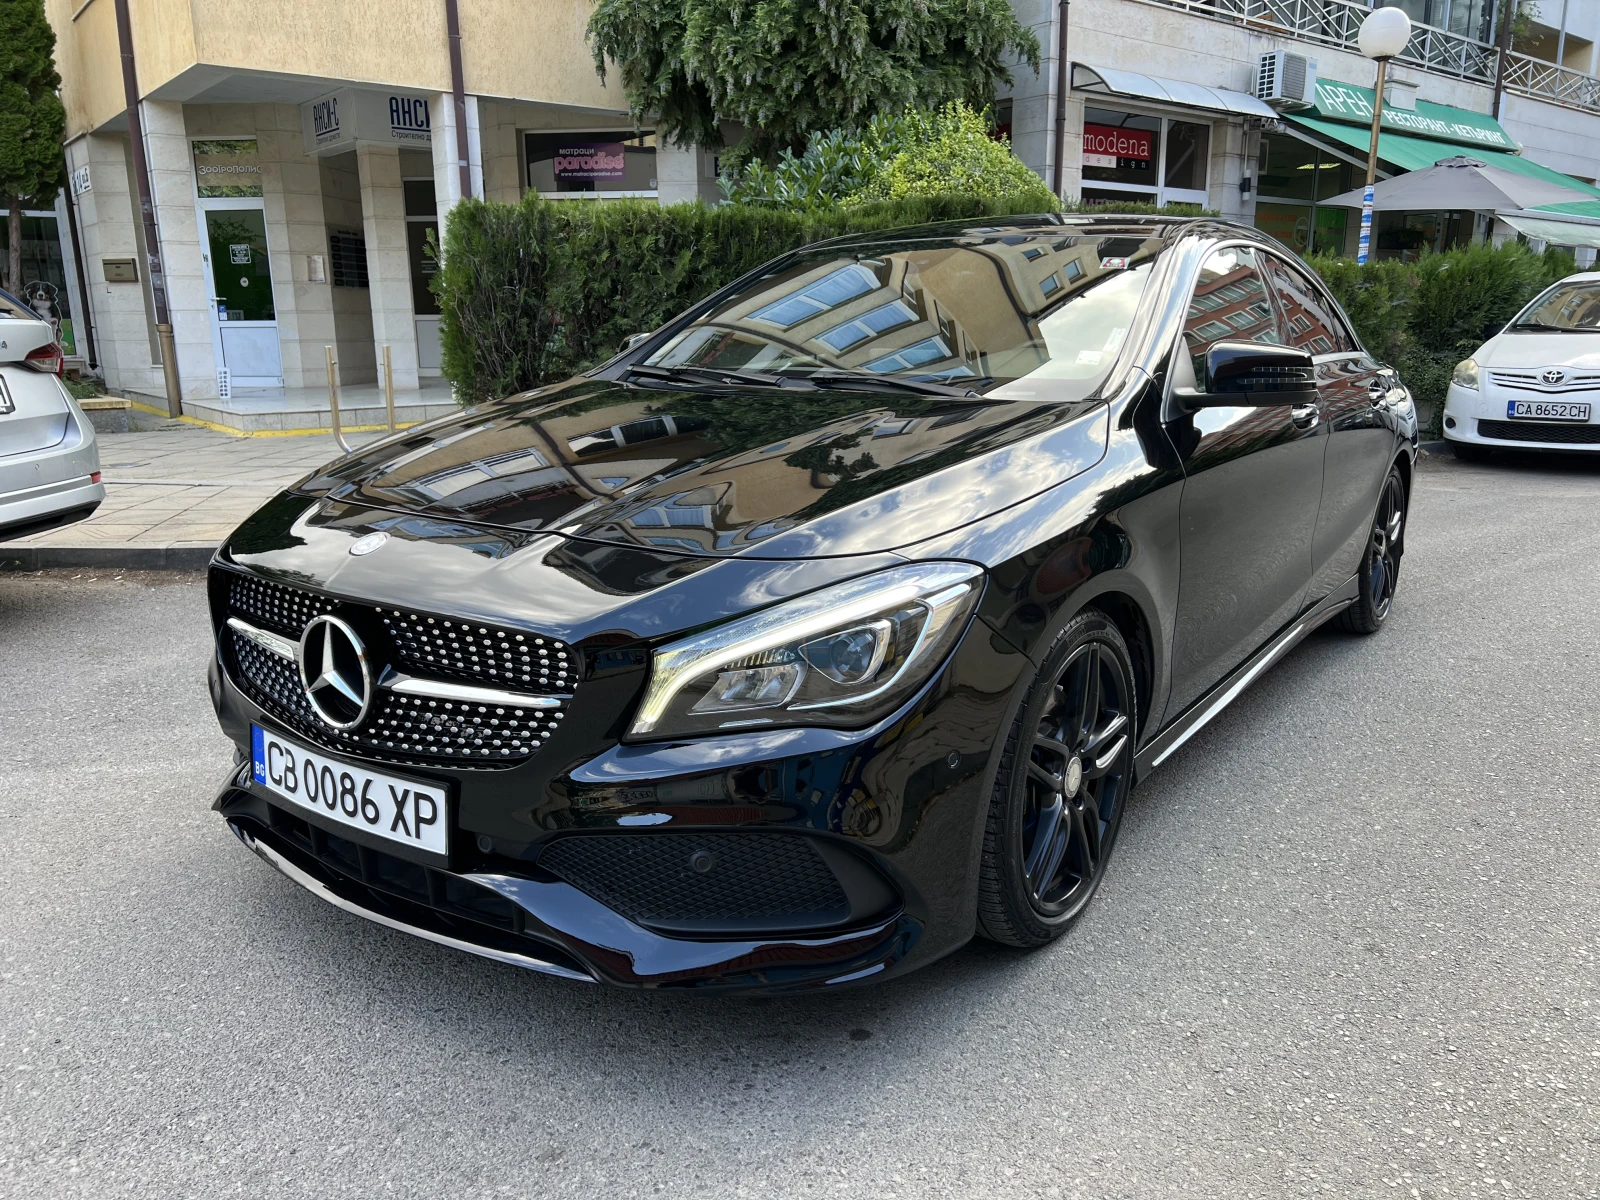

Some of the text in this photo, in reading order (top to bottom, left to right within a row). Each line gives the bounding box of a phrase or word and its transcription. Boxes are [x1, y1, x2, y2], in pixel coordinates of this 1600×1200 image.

[313, 98, 339, 133] АНСИ-С
[1382, 110, 1451, 134] РЕСТОРАНТ
[559, 148, 595, 156] матраци
[1083, 132, 1148, 156] modena
[554, 152, 625, 174] paradise
[1516, 403, 1532, 415] CA
[1535, 404, 1567, 416] 8652
[1569, 405, 1587, 417] CH
[255, 741, 438, 840] BG CB 0086 XP
